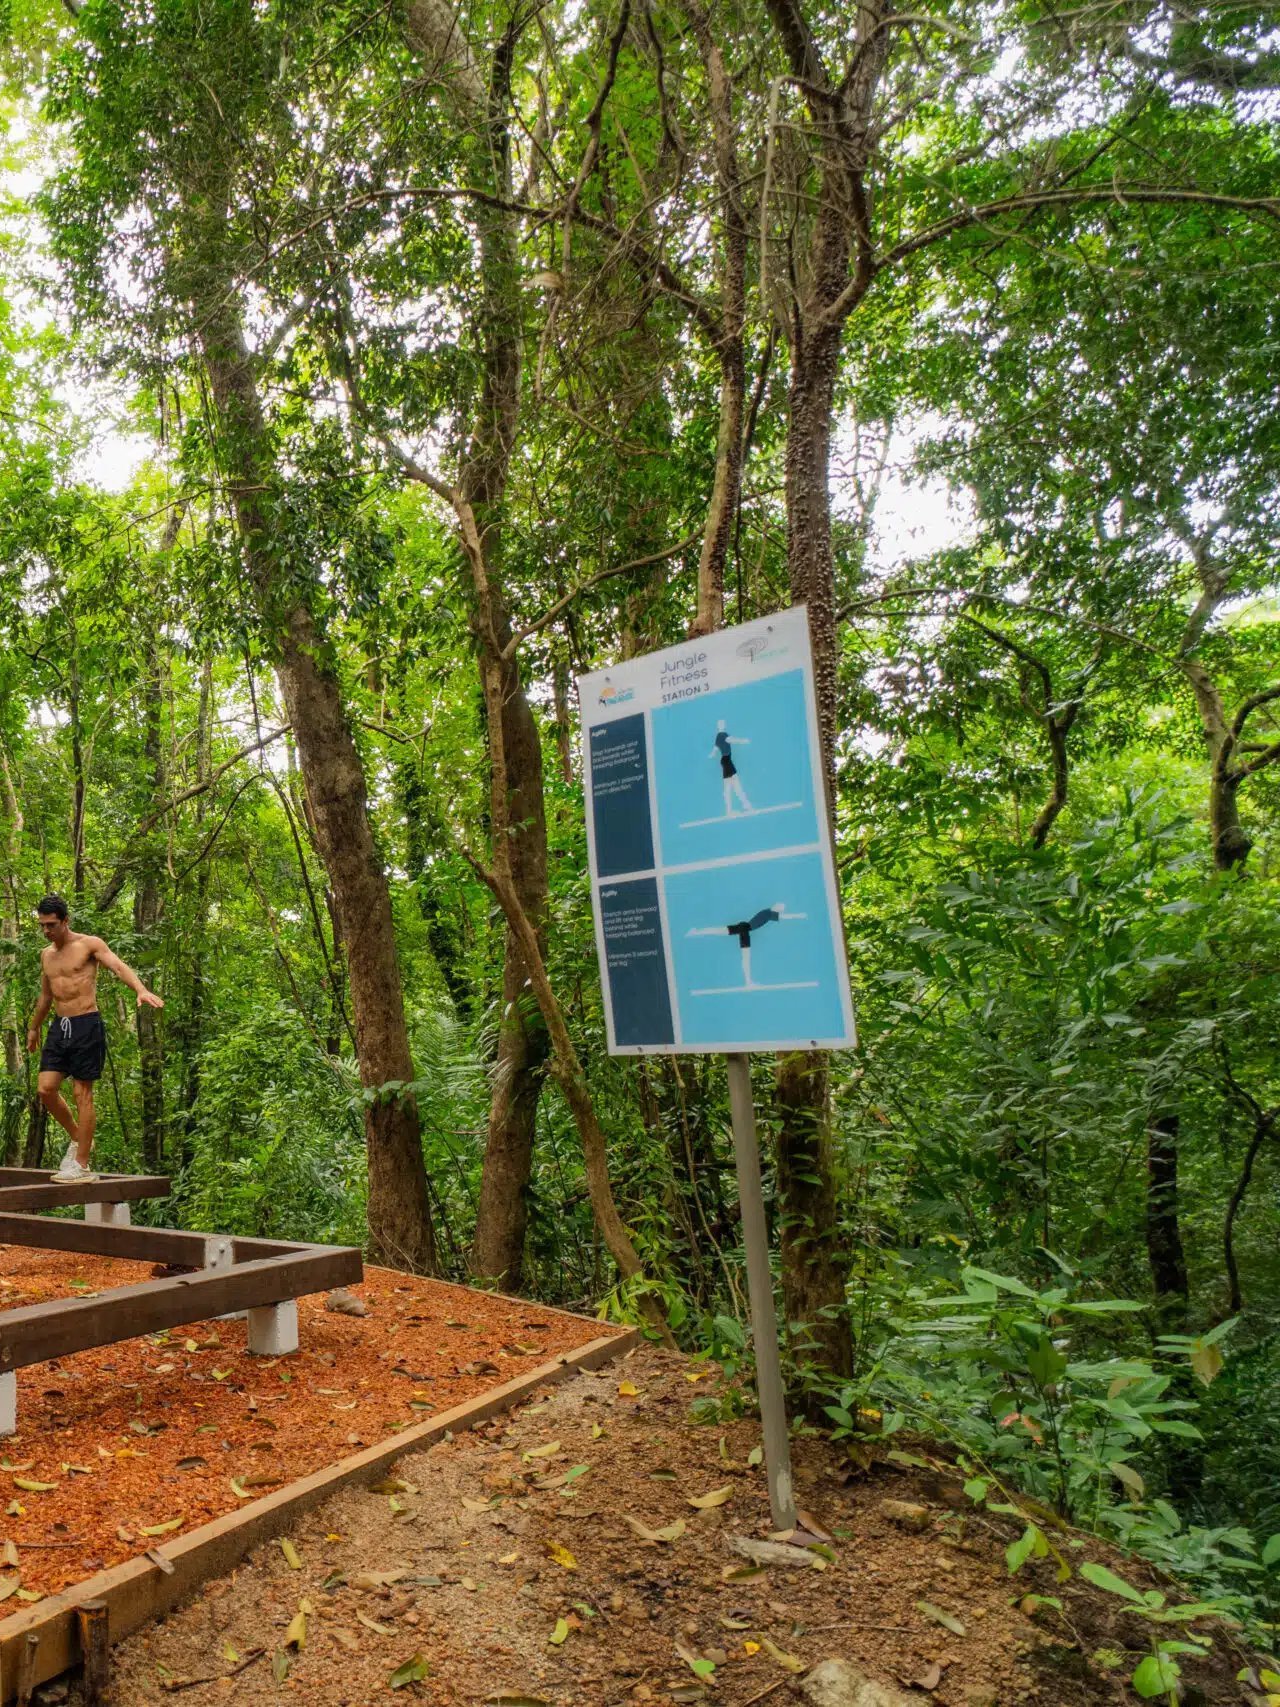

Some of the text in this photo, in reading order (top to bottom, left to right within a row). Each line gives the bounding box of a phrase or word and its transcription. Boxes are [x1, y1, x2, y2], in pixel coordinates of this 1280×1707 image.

[661, 653, 707, 674] Jungle
[660, 667, 708, 689] Fitness
[662, 682, 710, 703] STATION 3
[601, 890, 617, 898] Agility
